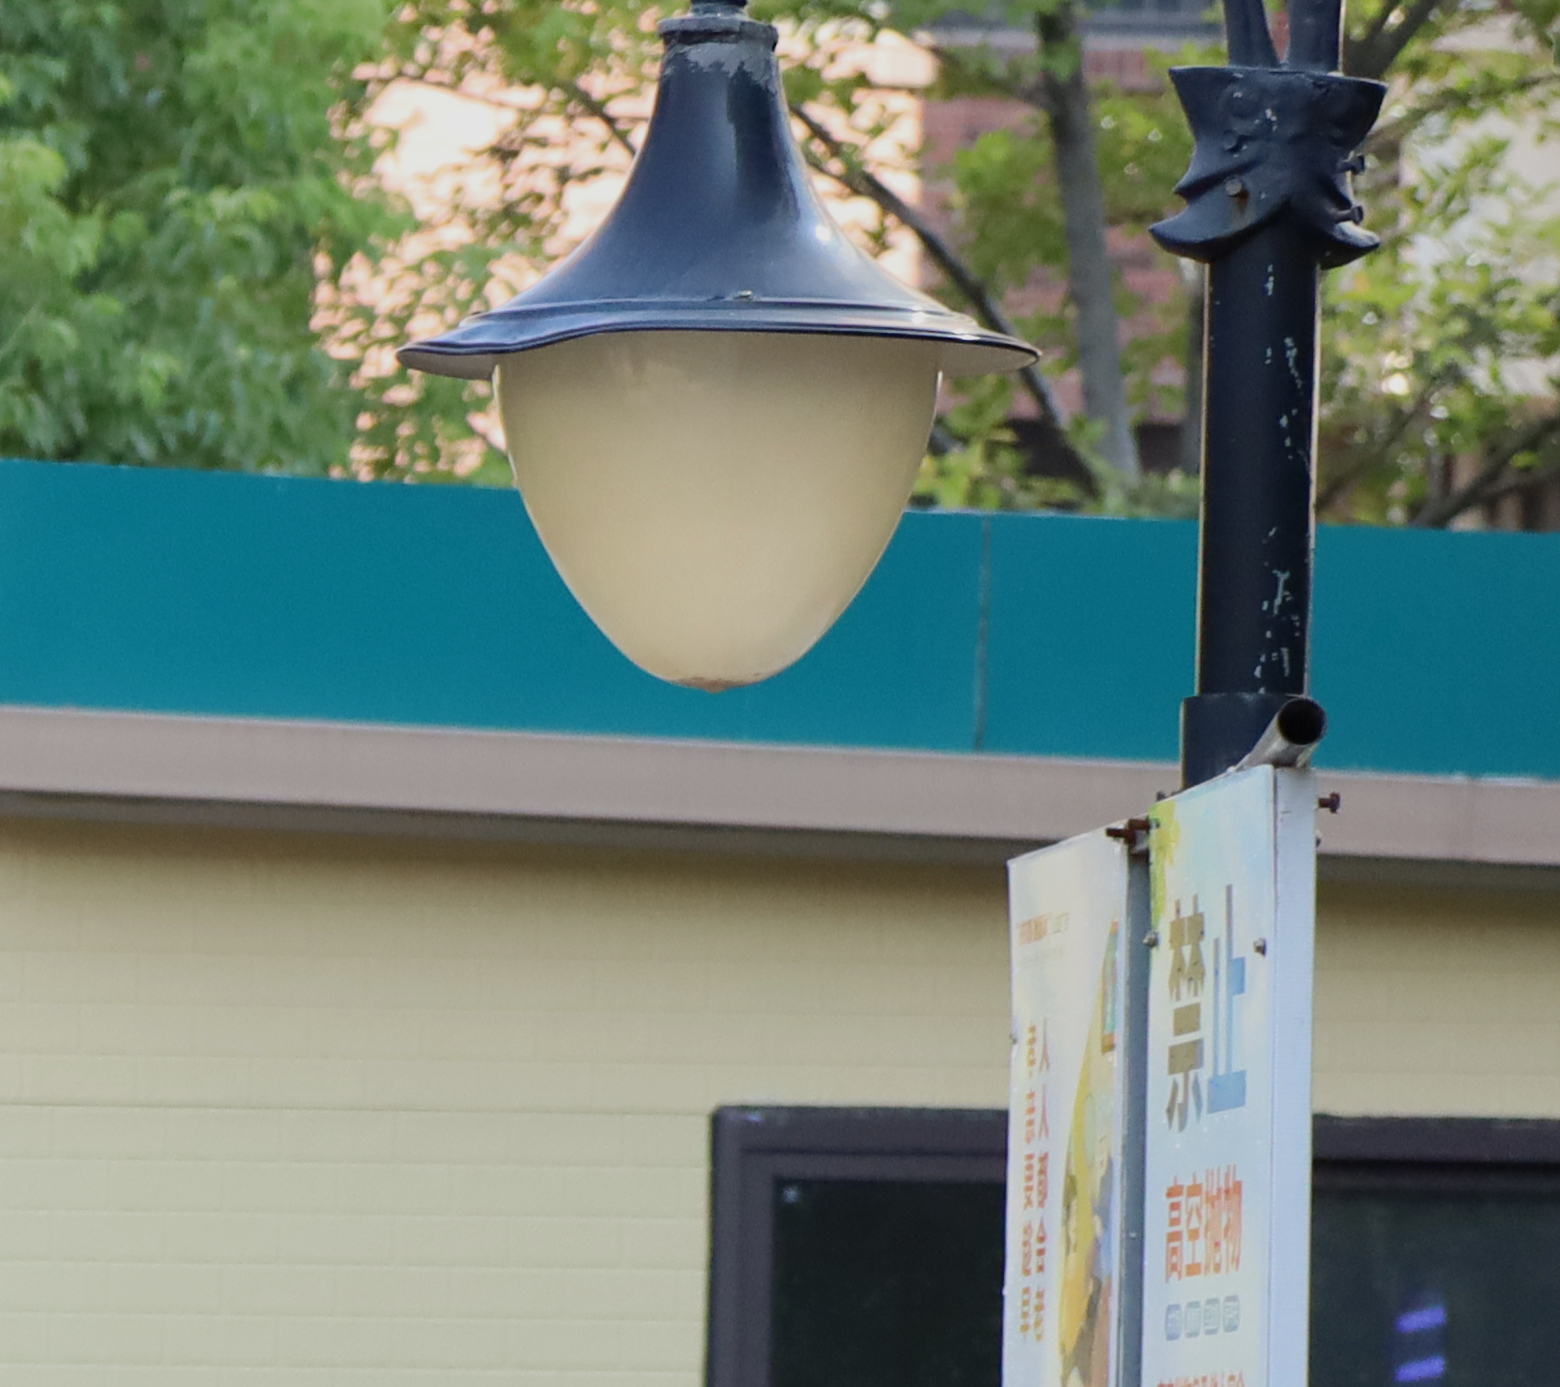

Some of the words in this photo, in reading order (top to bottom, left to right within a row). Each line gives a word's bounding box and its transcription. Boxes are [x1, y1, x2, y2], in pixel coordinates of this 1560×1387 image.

[1165, 884, 1247, 1132] 禁止
[1165, 1164, 1244, 1284] 高空抛物
